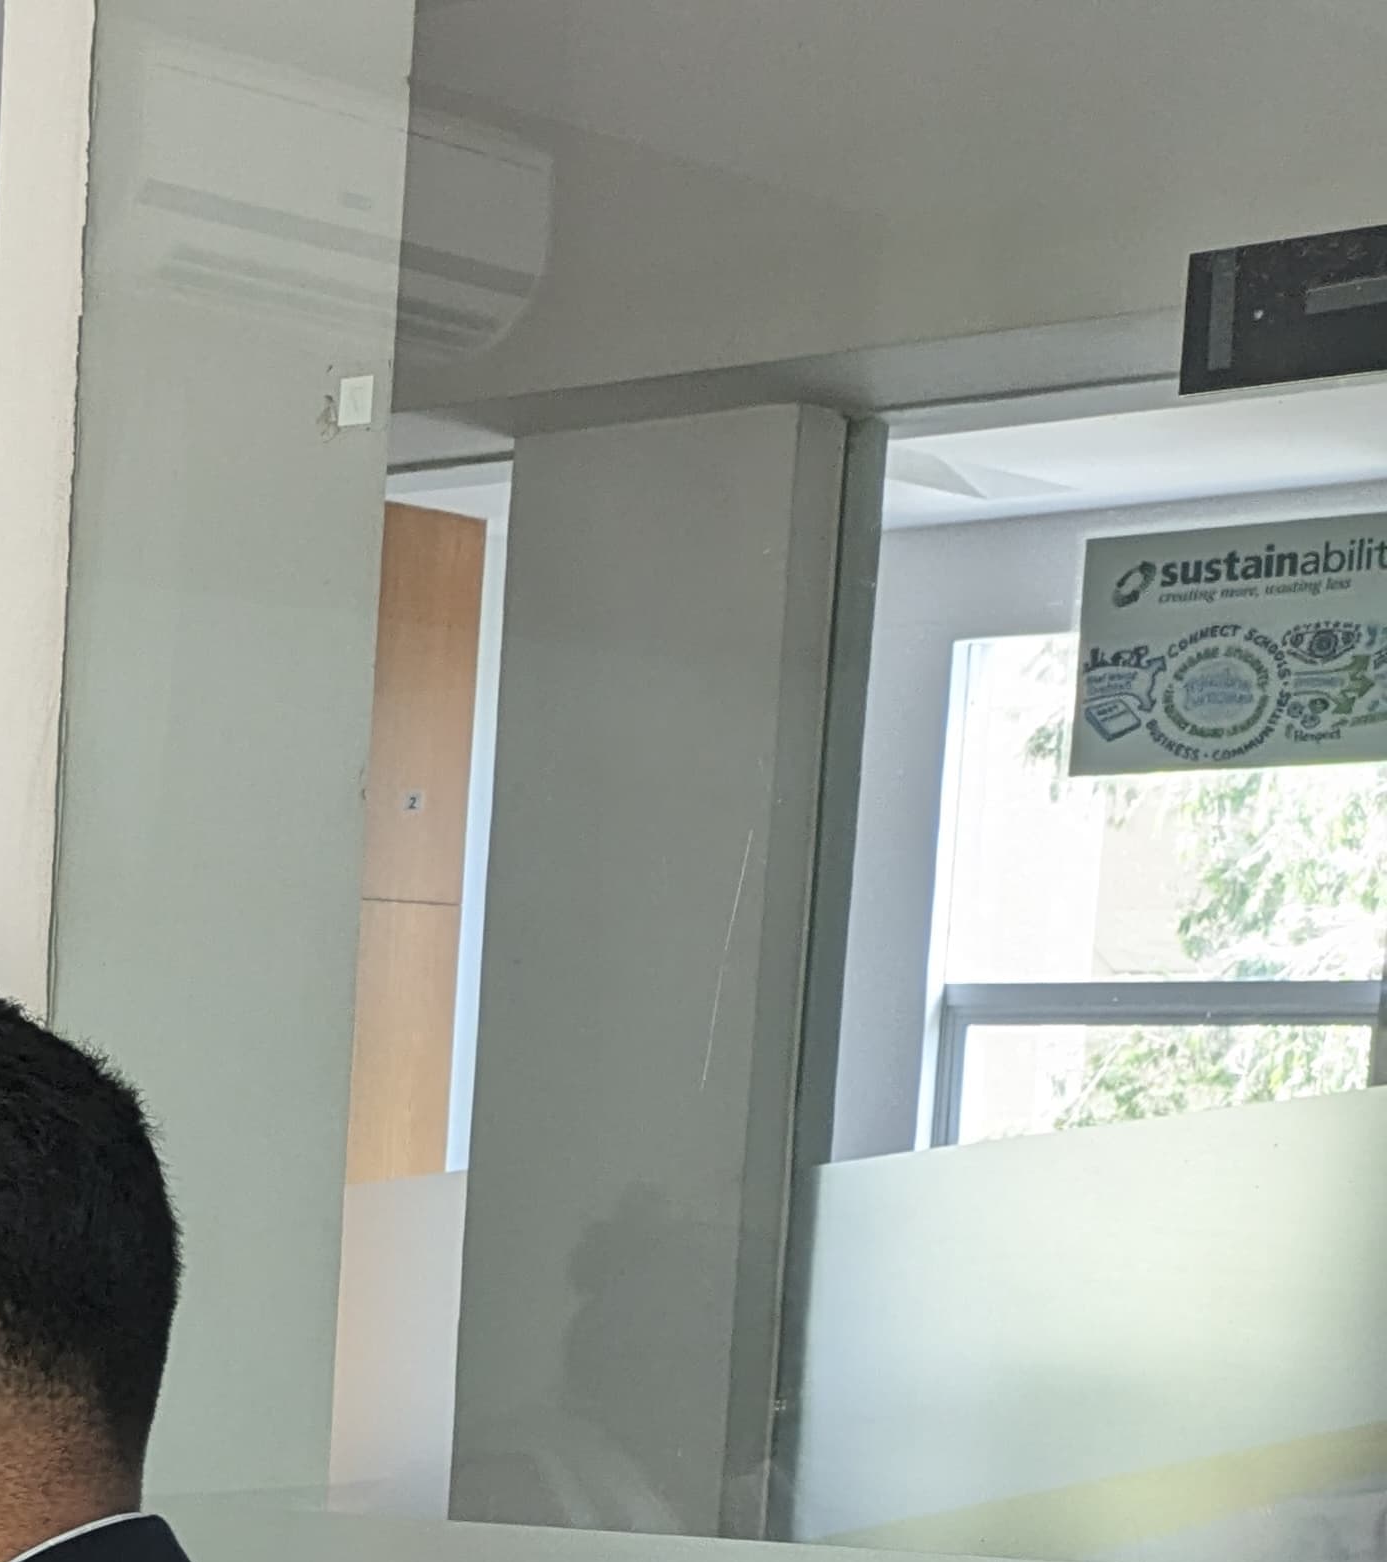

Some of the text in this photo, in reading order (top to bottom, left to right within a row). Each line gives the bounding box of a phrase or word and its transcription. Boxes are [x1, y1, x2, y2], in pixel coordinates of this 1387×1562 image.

[1158, 587, 1217, 604] creating
[1325, 576, 1352, 591] less
[1167, 624, 1292, 680] CONNECT SCHOOLS
